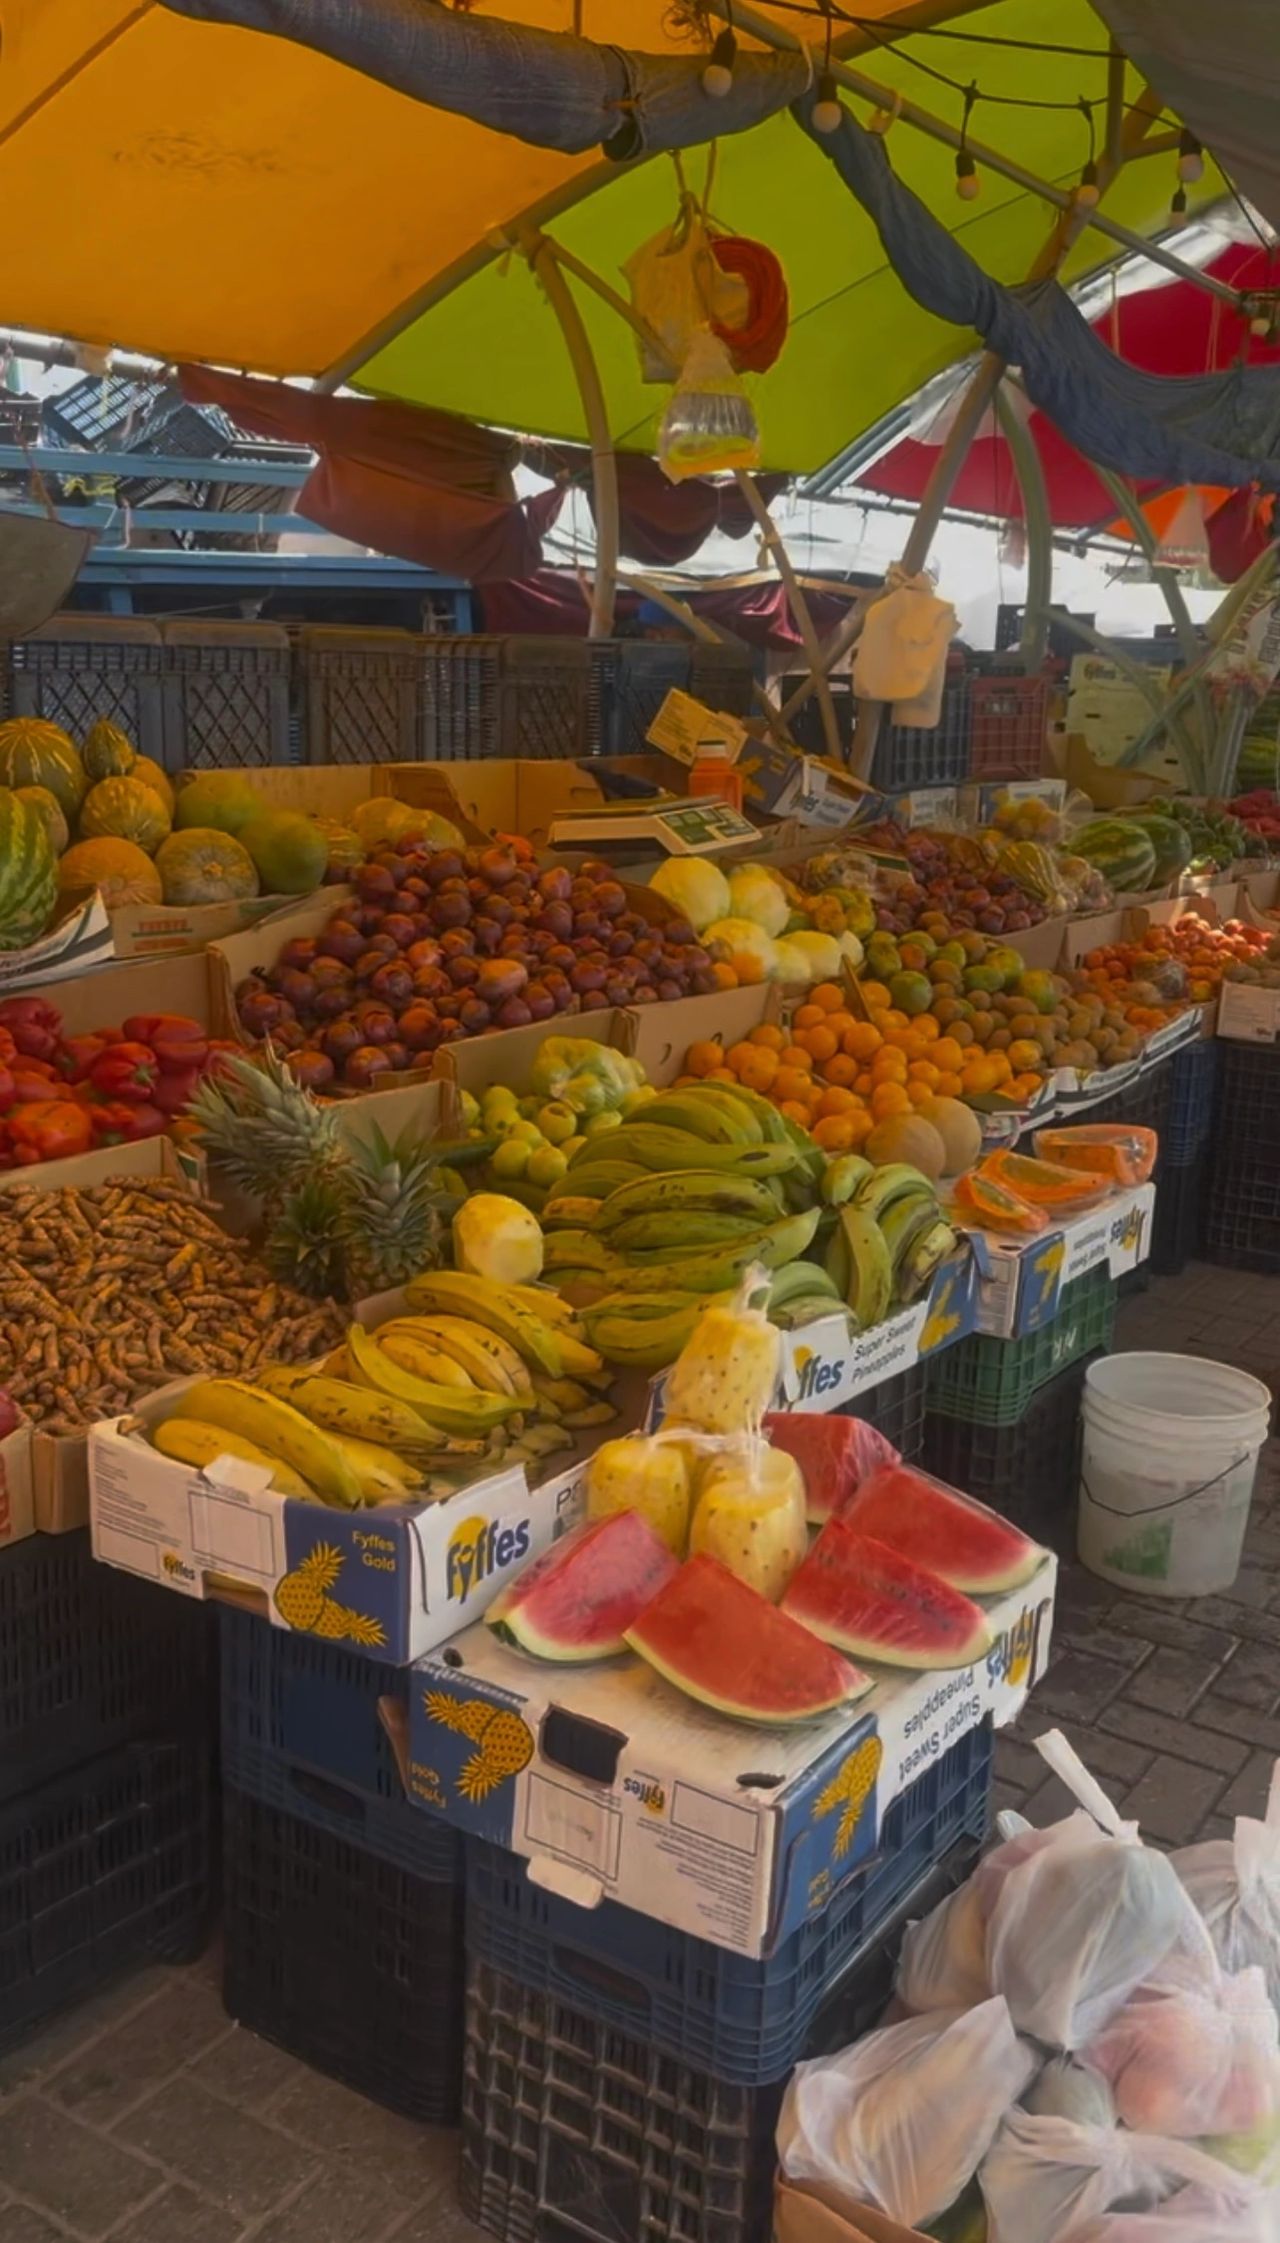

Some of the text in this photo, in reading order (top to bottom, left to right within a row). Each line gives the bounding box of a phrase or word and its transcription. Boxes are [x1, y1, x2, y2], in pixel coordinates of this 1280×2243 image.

[352, 1530, 396, 1552] Fyffes
[362, 1551, 396, 1572] Gold
[446, 1518, 530, 1604] fyffes
[898, 1694, 981, 1783] Super Sweet
[903, 1664, 975, 1740] Pineapples
